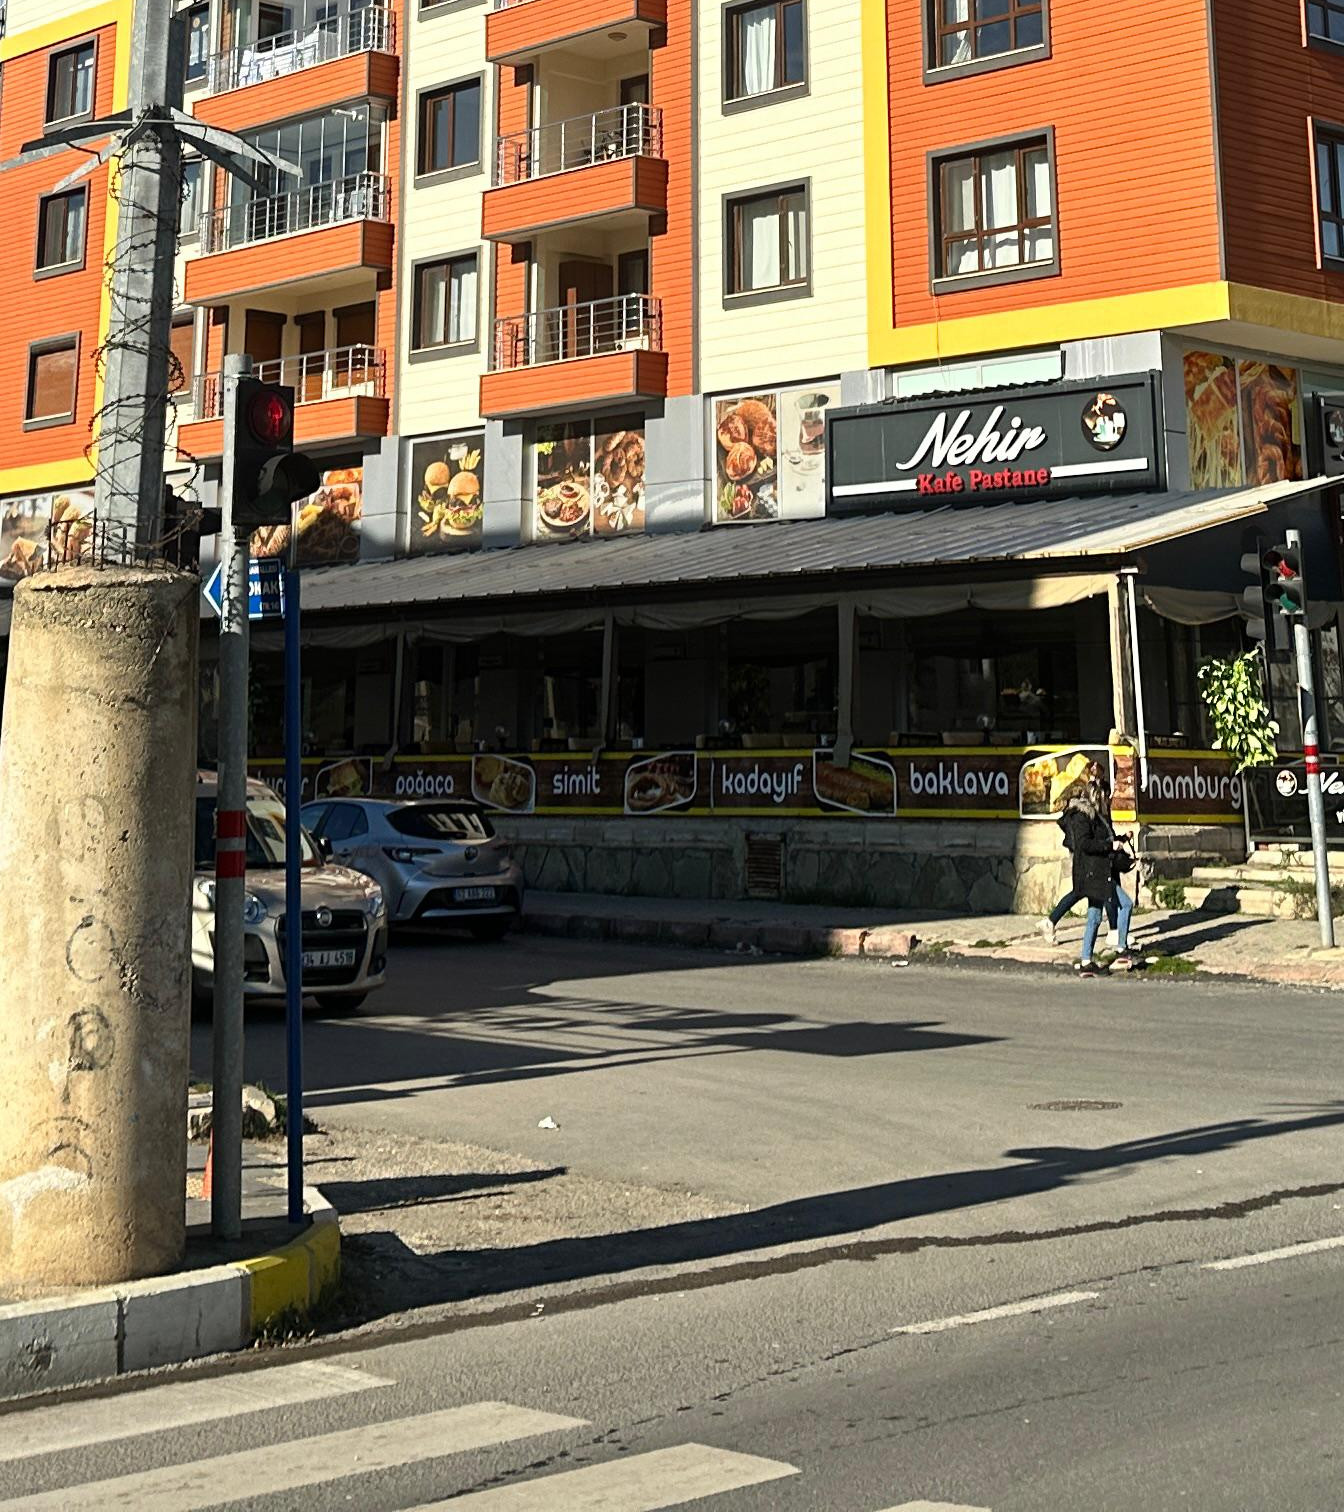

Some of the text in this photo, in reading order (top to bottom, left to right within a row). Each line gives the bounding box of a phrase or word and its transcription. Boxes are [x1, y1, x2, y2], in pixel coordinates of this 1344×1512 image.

[895, 405, 1046, 470] Nehir
[917, 467, 1049, 495] Kafe Pastane
[552, 766, 601, 795] simit
[721, 763, 804, 803] kadayıf
[909, 762, 1009, 795] baklava
